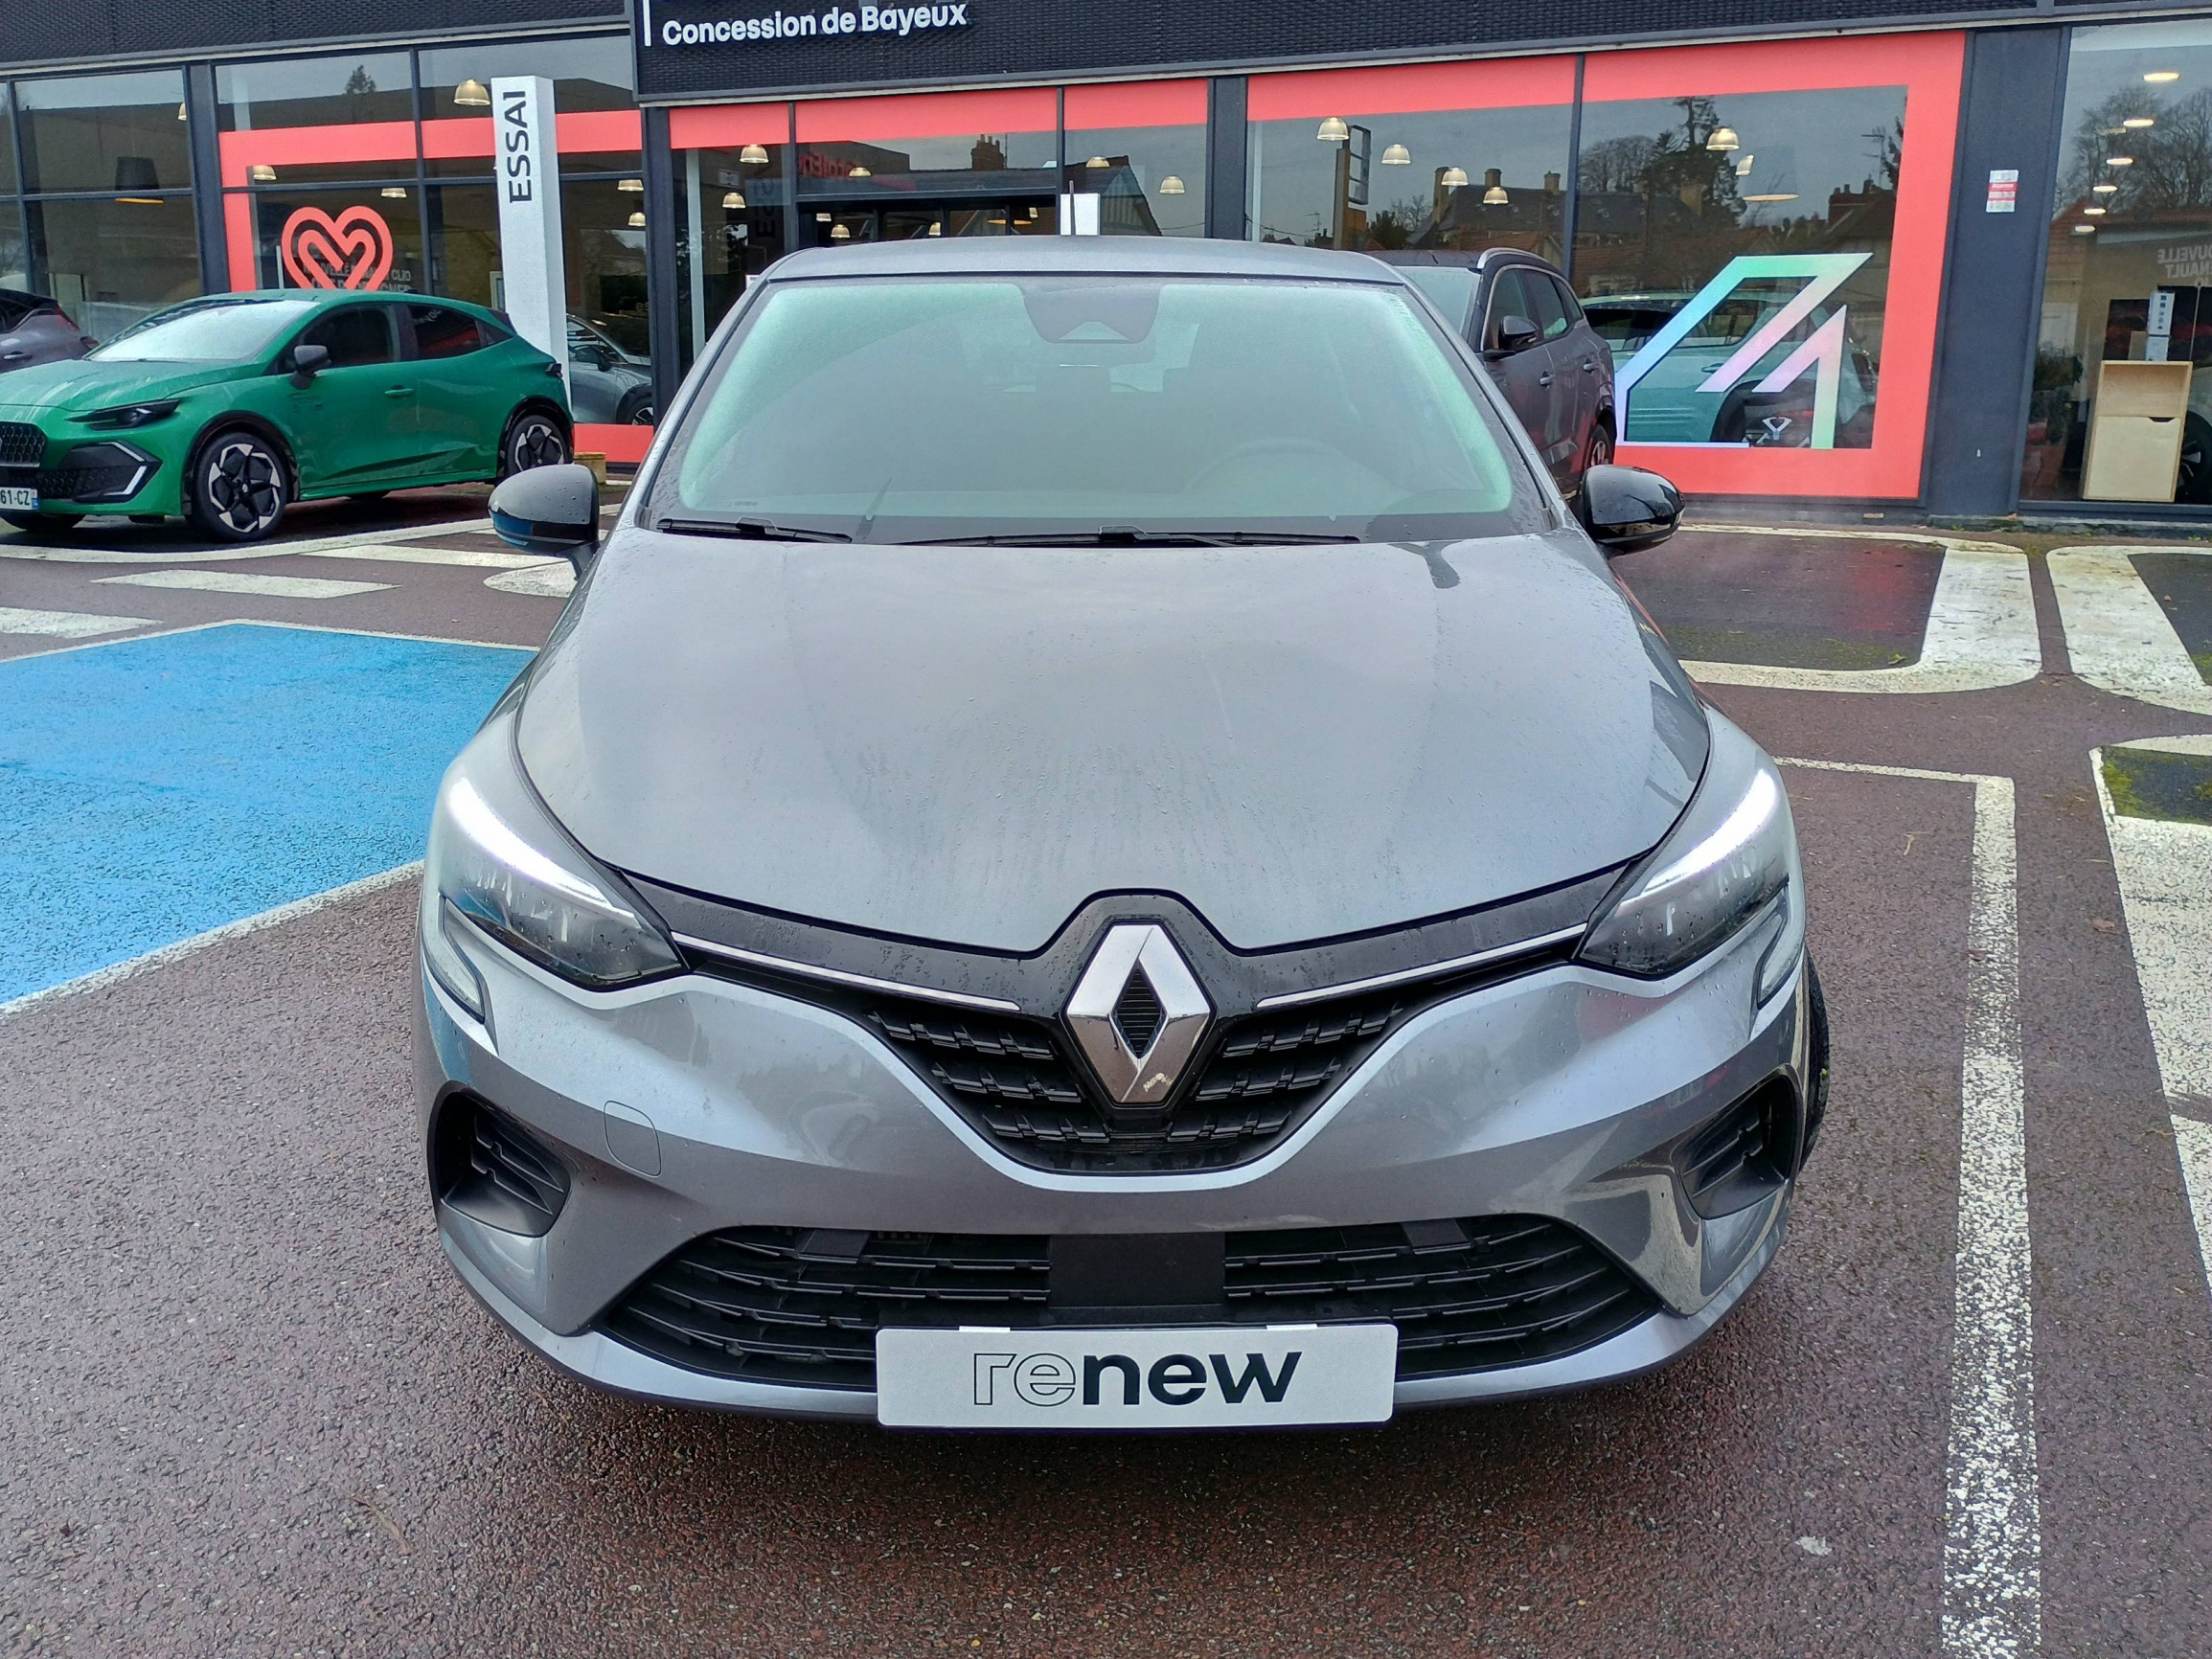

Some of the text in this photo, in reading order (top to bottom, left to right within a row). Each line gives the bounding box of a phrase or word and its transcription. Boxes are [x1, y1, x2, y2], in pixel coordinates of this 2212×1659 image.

[662, 4, 968, 46] Concession de Bayeux
[503, 91, 532, 203] ESSAI
[391, 269, 411, 282] CLIO
[973, 1351, 1303, 1407] renew
